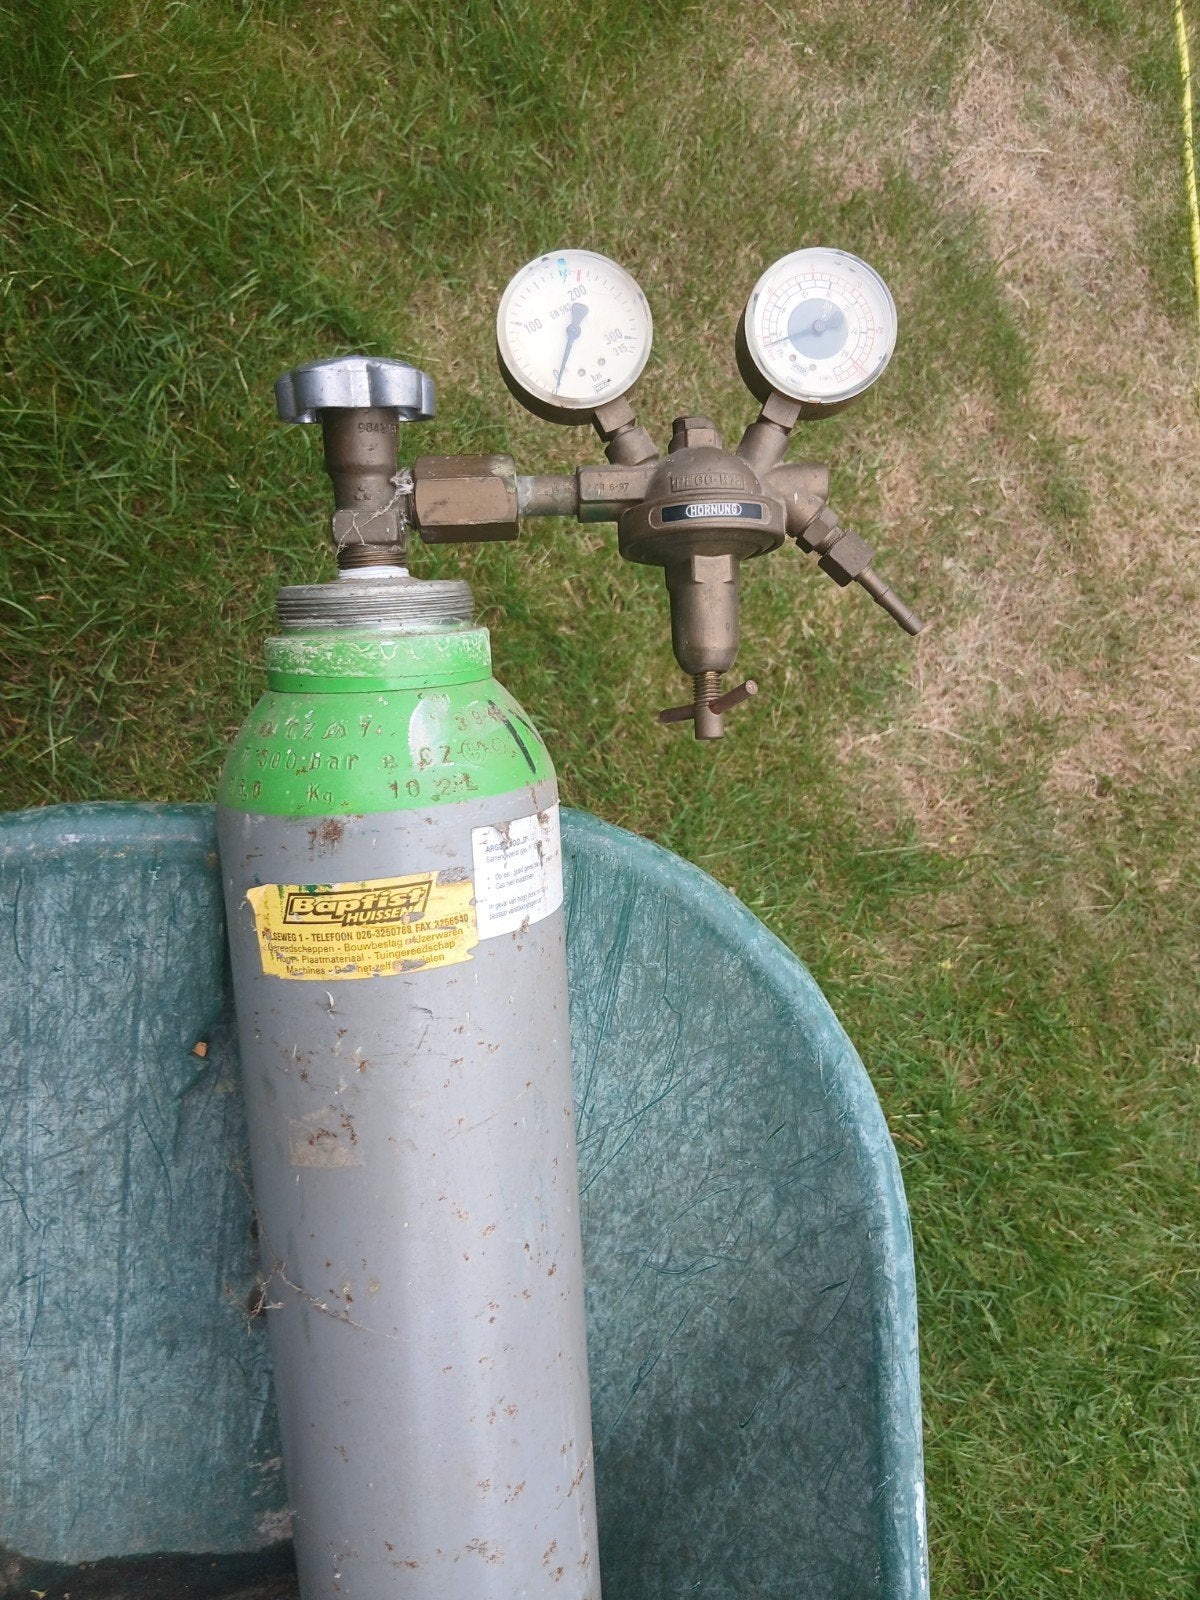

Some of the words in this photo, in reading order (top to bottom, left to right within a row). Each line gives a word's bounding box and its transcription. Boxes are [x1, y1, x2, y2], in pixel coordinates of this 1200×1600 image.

[568, 284, 587, 301] 200
[524, 318, 543, 335] 100
[604, 328, 623, 345] 300
[613, 343, 628, 356] 315
[690, 503, 738, 516] HORNUNG
[290, 887, 426, 919] Baptist
[343, 904, 416, 927] HUISSEN
[262, 930, 297, 942] PLSEWEG
[311, 931, 353, 943] TELEFOON
[356, 923, 412, 940] 026-3250788
[415, 921, 431, 933] FAX
[267, 942, 335, 955] Gereedschappen
[344, 937, 403, 952] Bouwbeslag
[301, 953, 364, 964] Plaatmateriaal
[374, 940, 455, 960] Tuingereedschap
